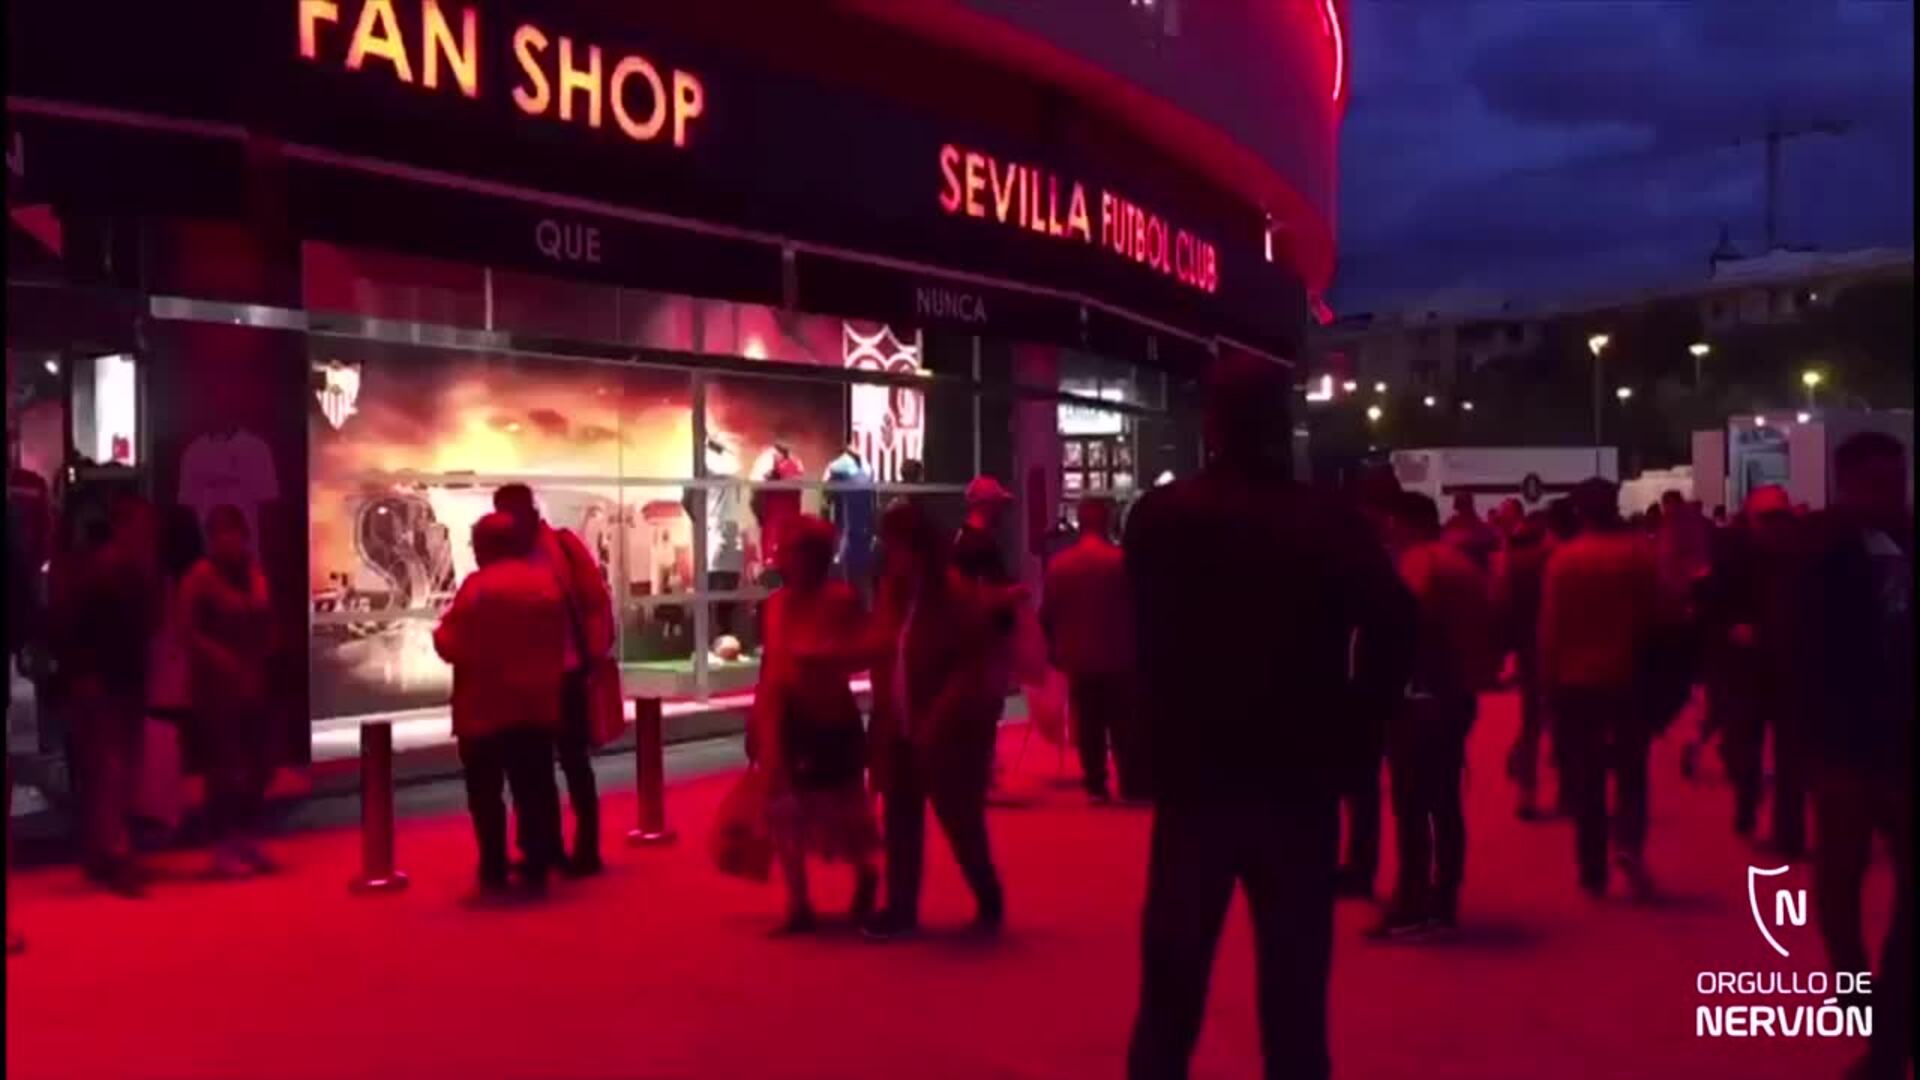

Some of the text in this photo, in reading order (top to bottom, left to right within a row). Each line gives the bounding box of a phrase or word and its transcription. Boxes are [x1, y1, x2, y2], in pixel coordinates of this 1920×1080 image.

[298, 0, 704, 148] FAN SHOP
[535, 218, 603, 264] QUE
[939, 143, 1219, 294] SEVILLA FUTBOL CLUB
[915, 287, 988, 324] NUNCA
